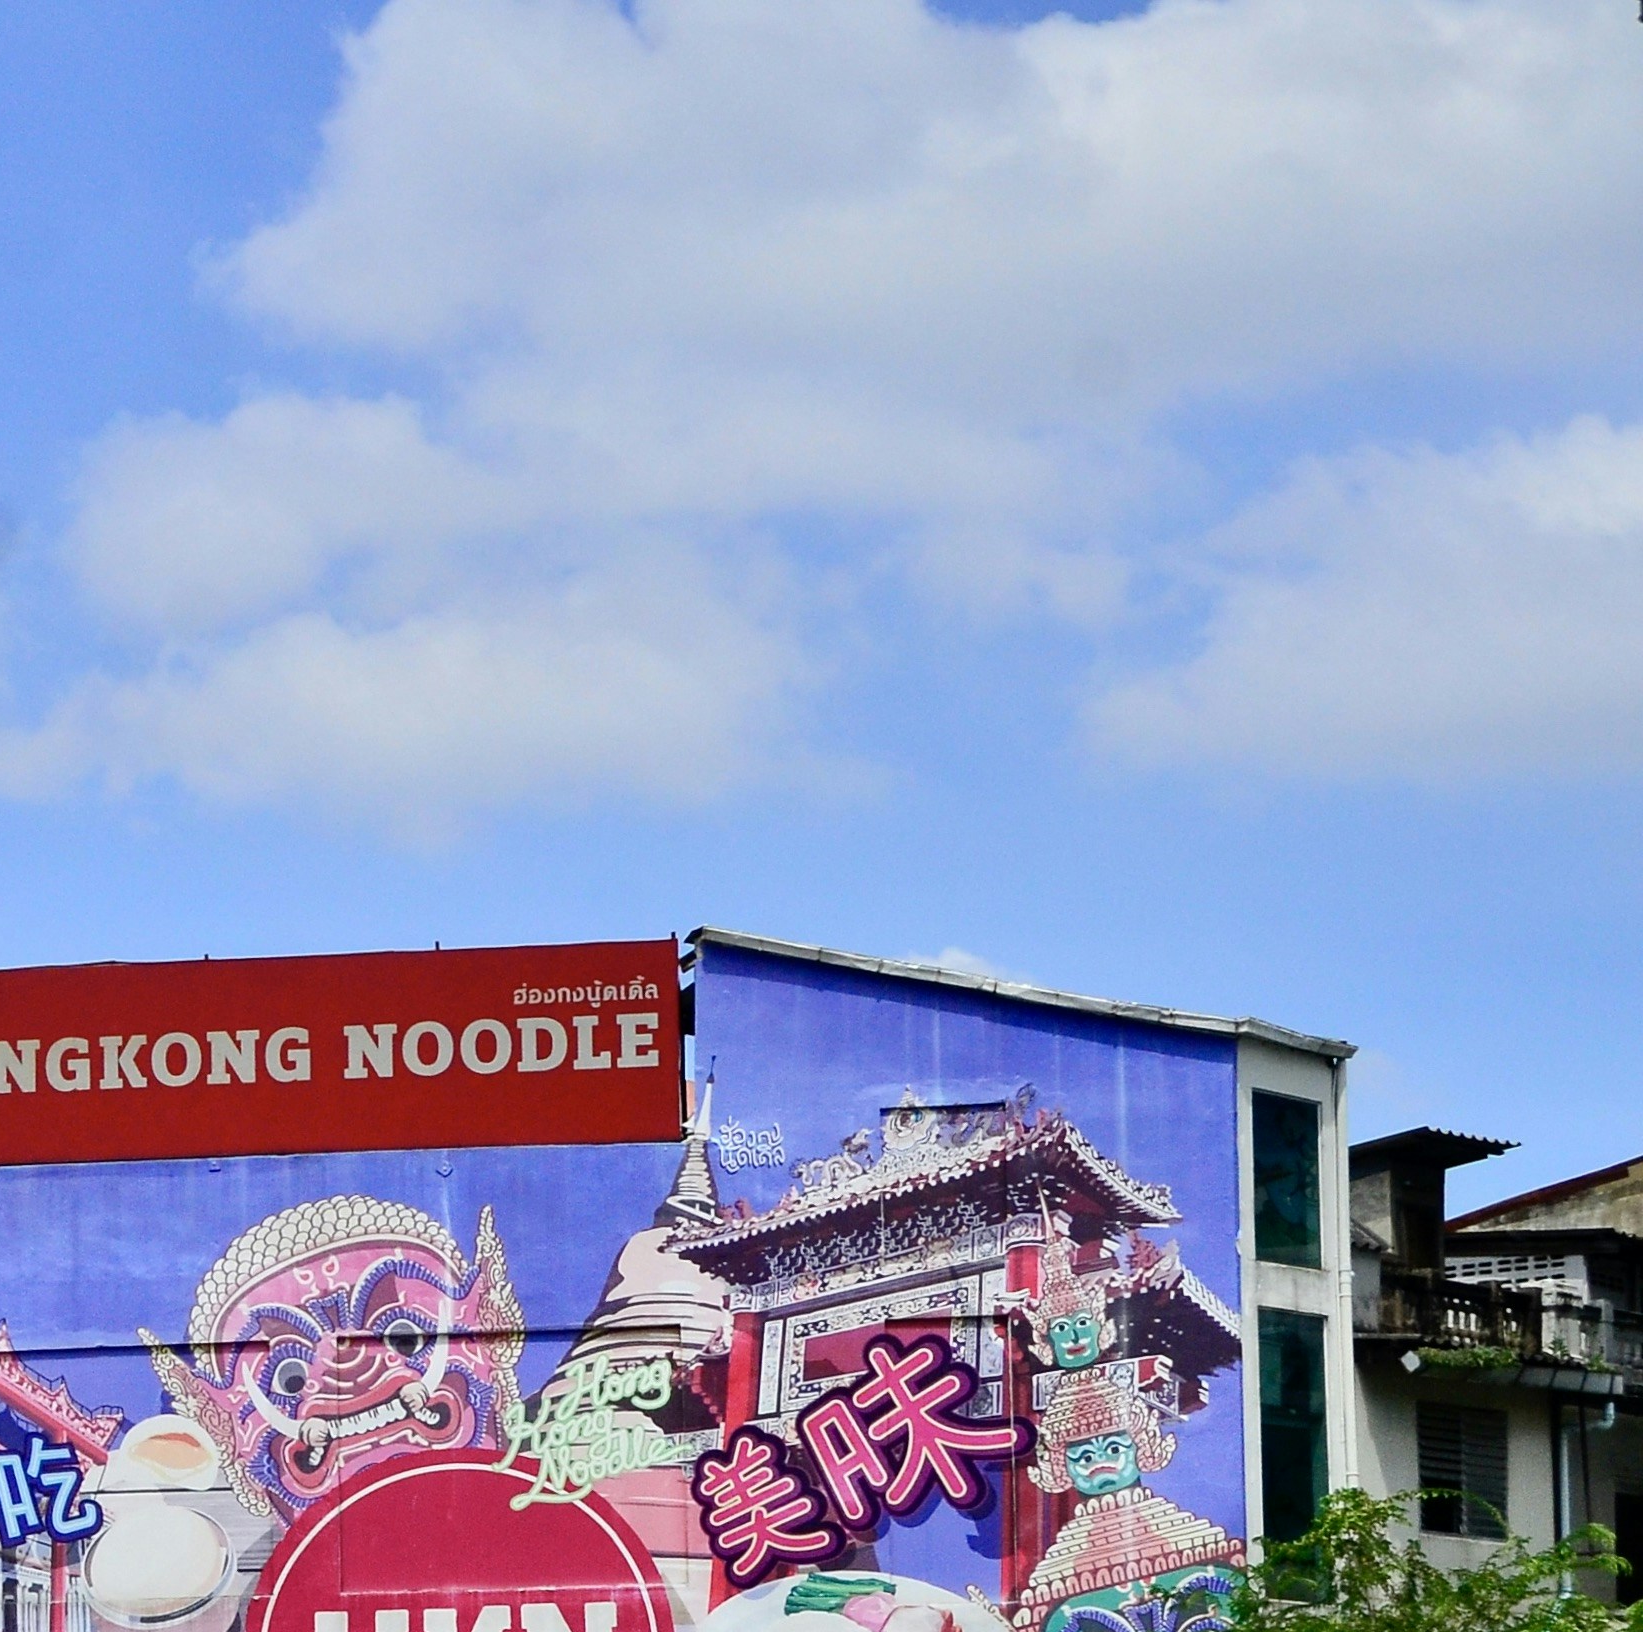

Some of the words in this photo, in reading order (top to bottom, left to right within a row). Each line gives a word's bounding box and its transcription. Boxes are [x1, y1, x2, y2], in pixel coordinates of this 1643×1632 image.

[342, 1012, 661, 1079] NOODLE
[555, 1353, 674, 1421] Hong
[491, 1396, 614, 1472] Kong
[509, 1426, 694, 1511] Noodle
[699, 1346, 1019, 1577] 美味
